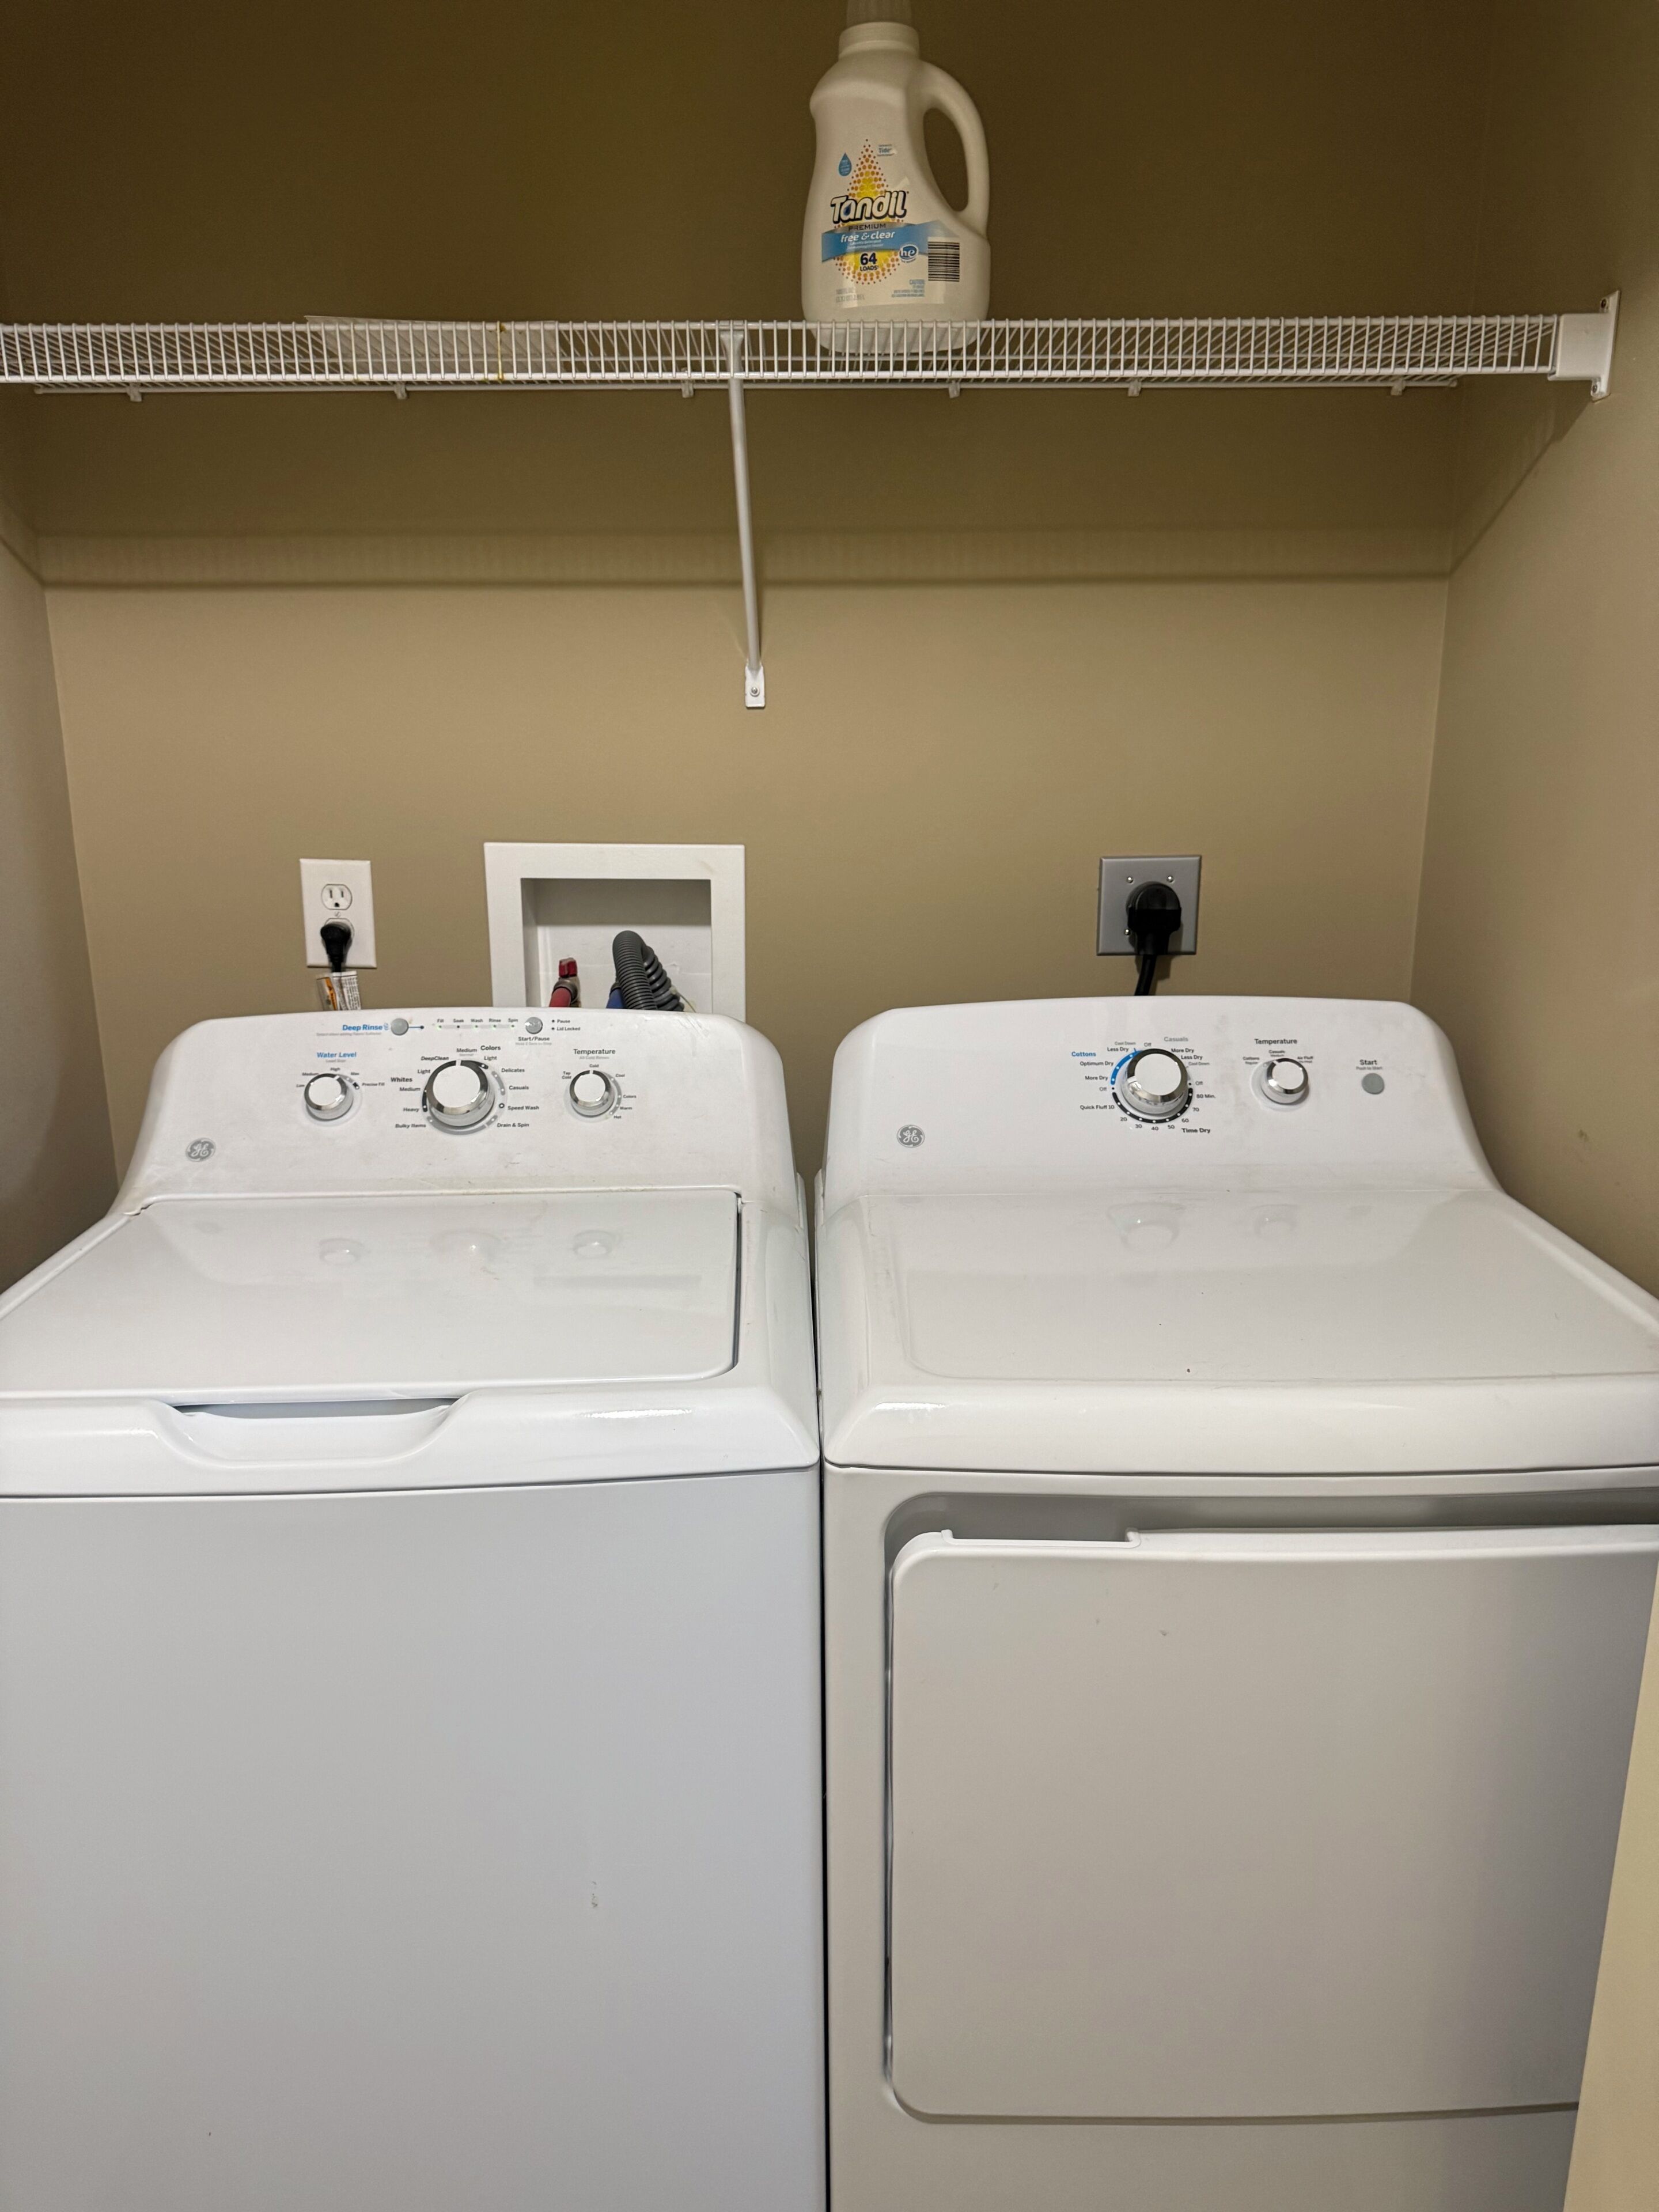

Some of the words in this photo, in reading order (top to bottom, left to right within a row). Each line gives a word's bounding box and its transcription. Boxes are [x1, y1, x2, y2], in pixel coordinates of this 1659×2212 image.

[830, 190, 907, 224] Tandil
[849, 223, 886, 231] PREMIUM
[841, 234, 859, 243] free
[870, 231, 896, 240] clear
[860, 252, 877, 266] 64
[900, 246, 917, 259] he
